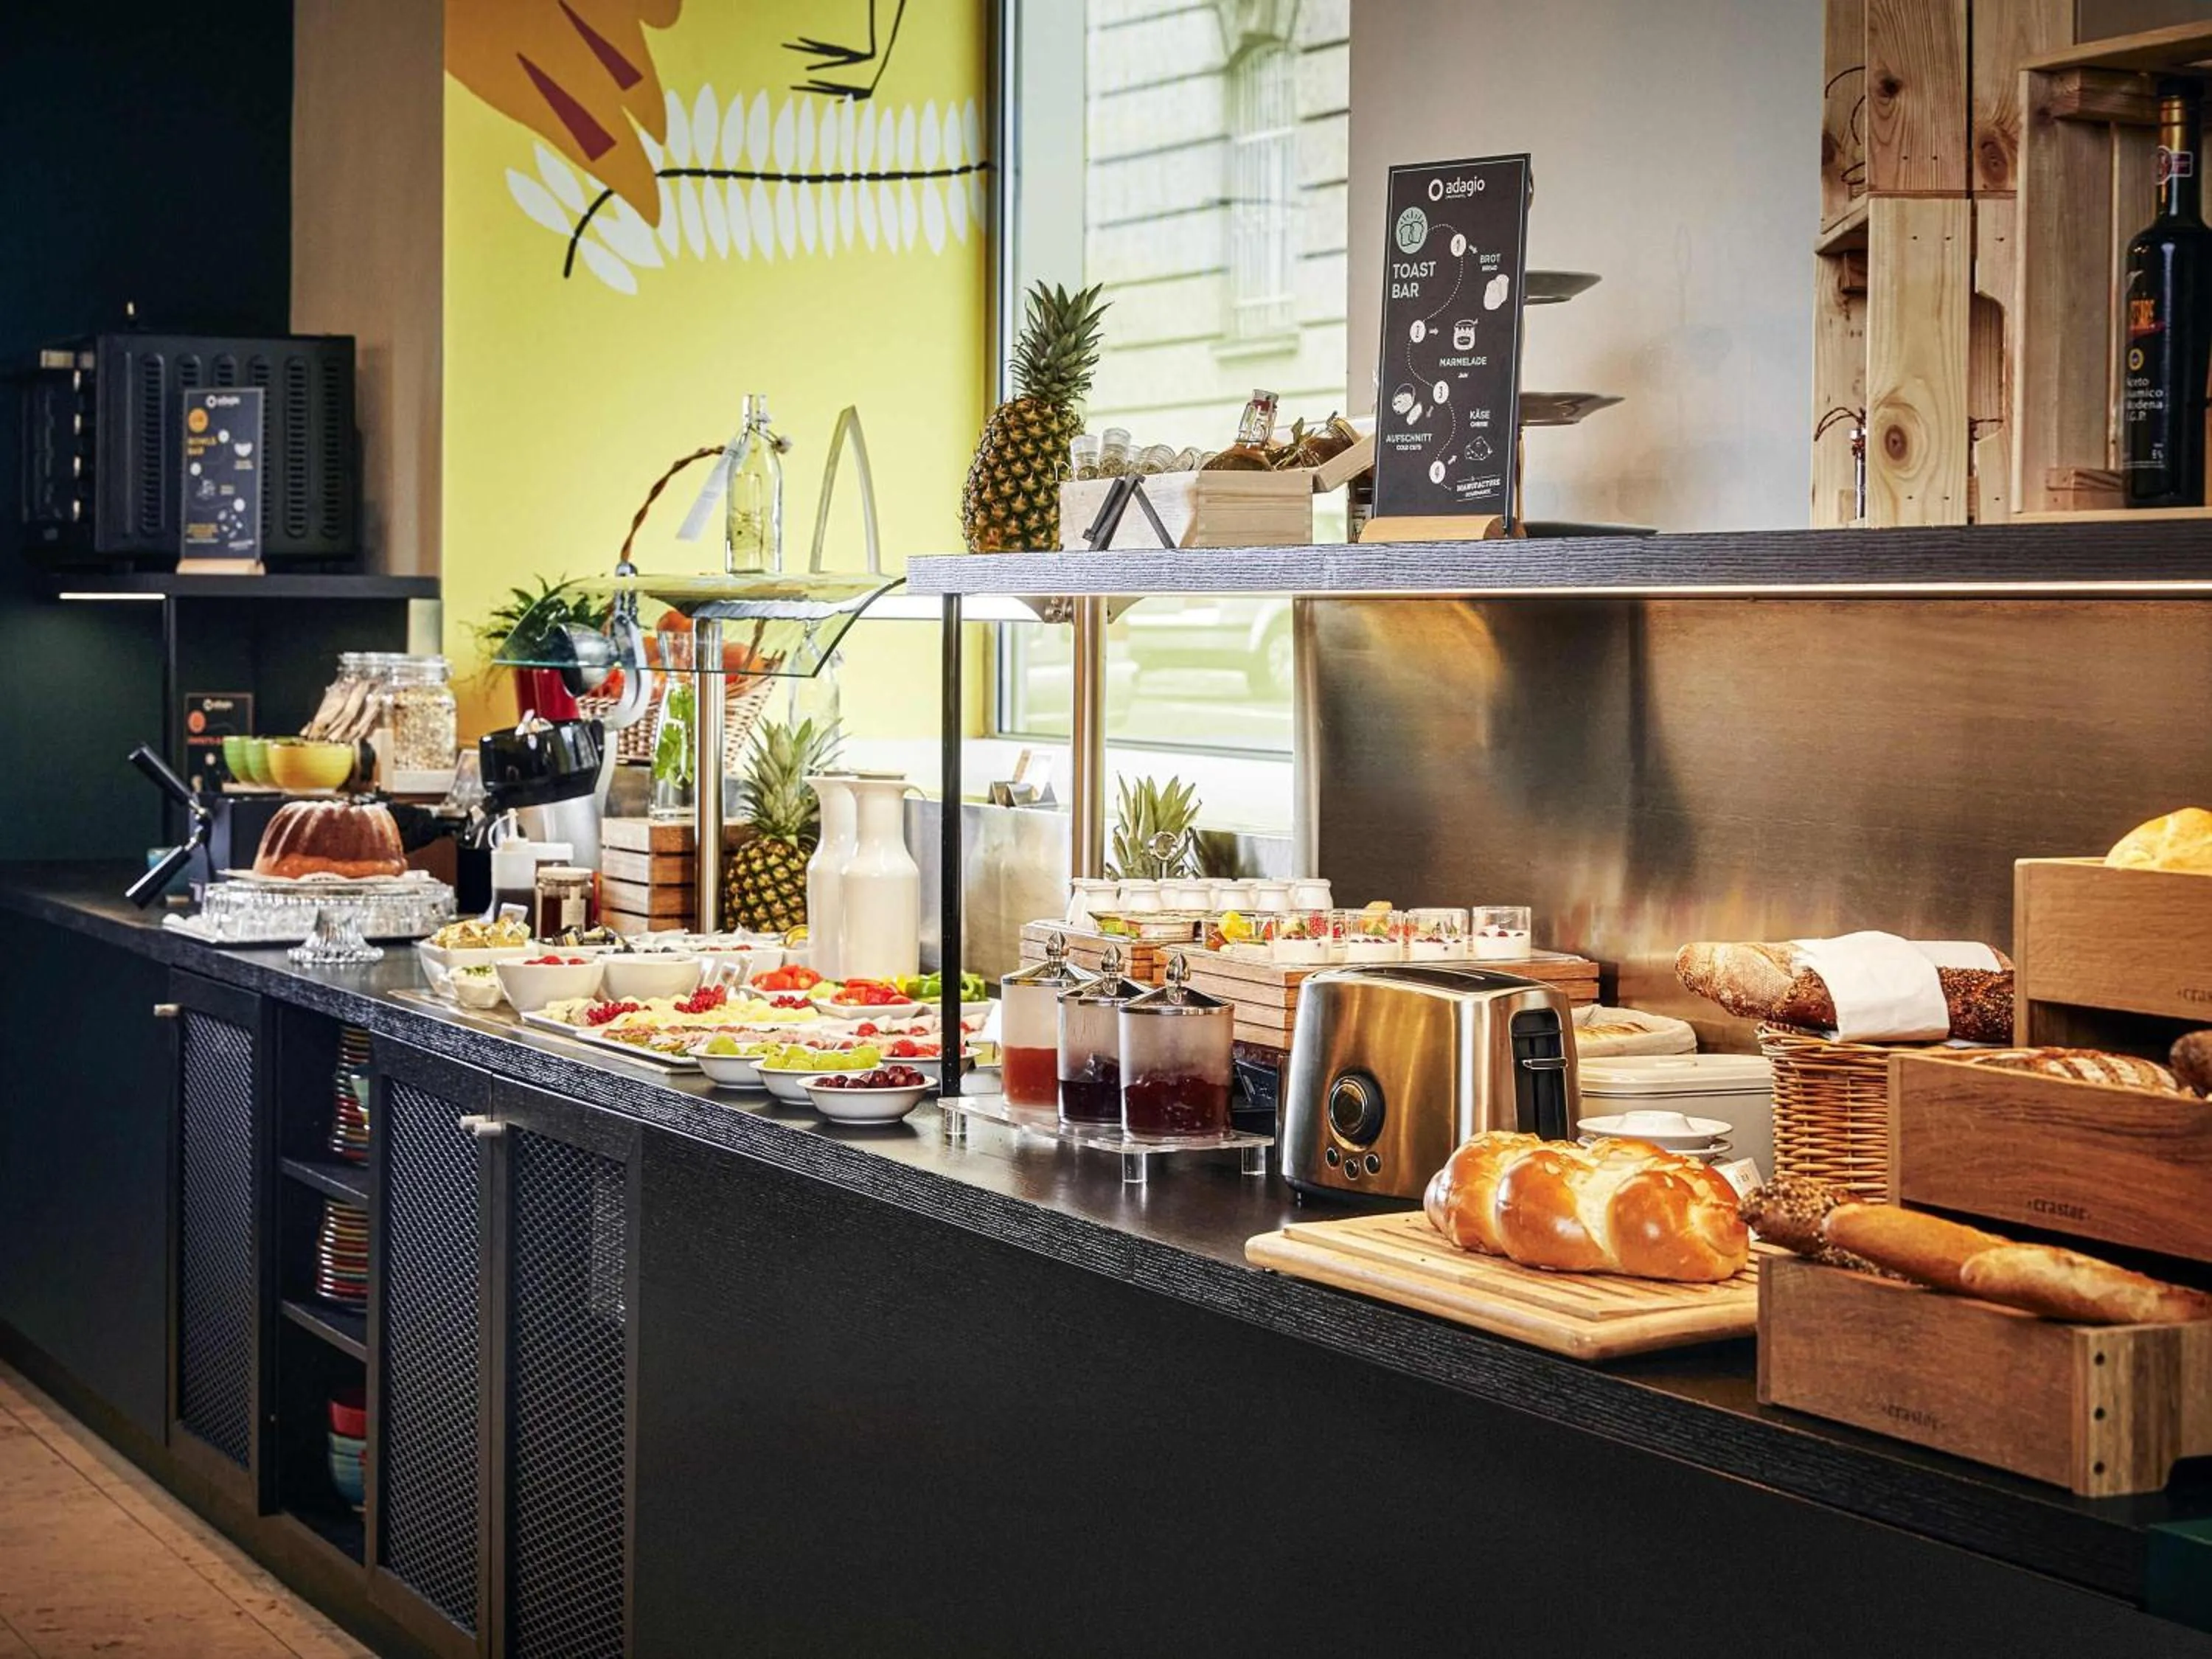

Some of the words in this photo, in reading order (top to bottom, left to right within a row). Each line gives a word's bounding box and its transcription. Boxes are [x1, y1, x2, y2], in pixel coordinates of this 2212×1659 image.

[1446, 175, 1486, 197] adagio
[1480, 253, 1501, 264] BROT
[1393, 261, 1437, 279] TOAST
[1391, 282, 1419, 299] BAR
[1439, 356, 1487, 366] MARMELADE
[1385, 433, 1433, 443] AUFSCHNITT
